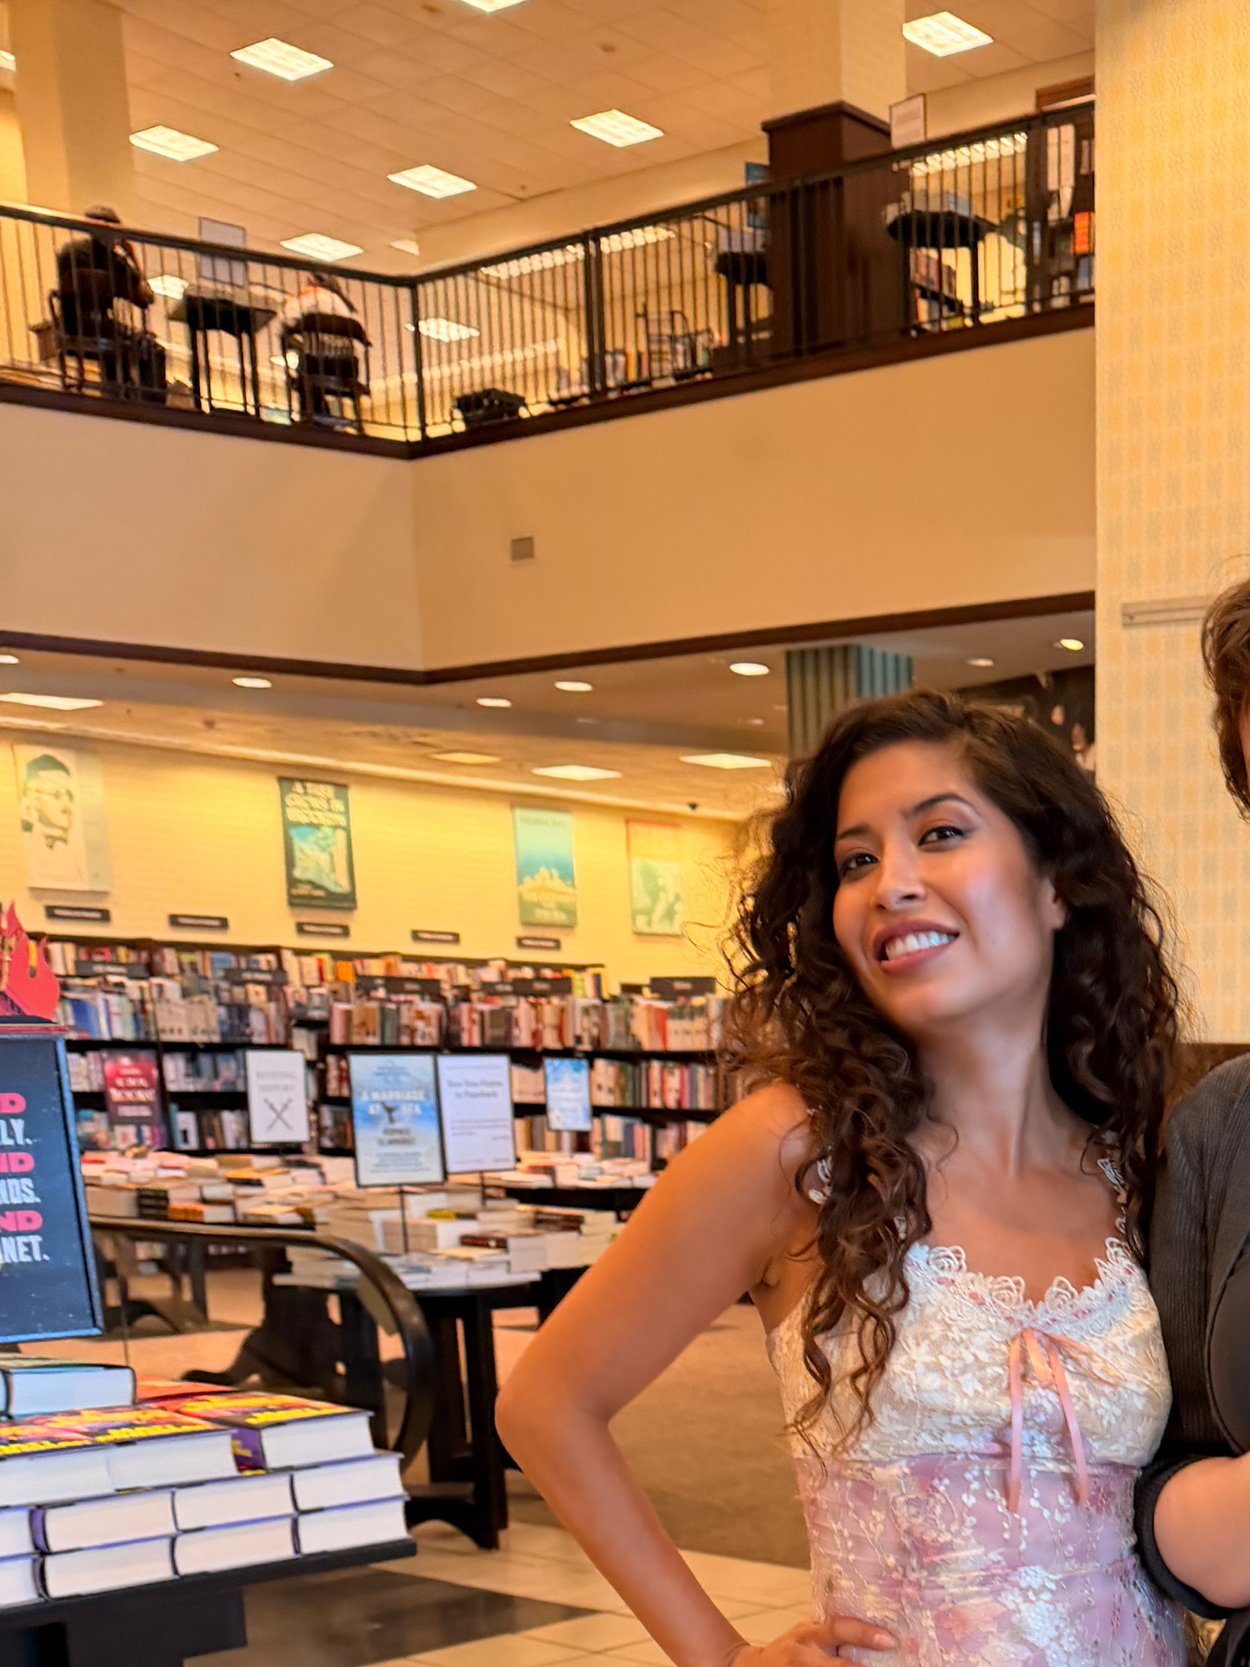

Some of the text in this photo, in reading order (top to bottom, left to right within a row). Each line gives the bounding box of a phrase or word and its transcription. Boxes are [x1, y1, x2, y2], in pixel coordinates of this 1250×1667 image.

[0, 1118, 33, 1146] LY.
[0, 1177, 42, 1204] NDS.
[0, 1210, 43, 1232] ND
[0, 1234, 51, 1263] NET.
